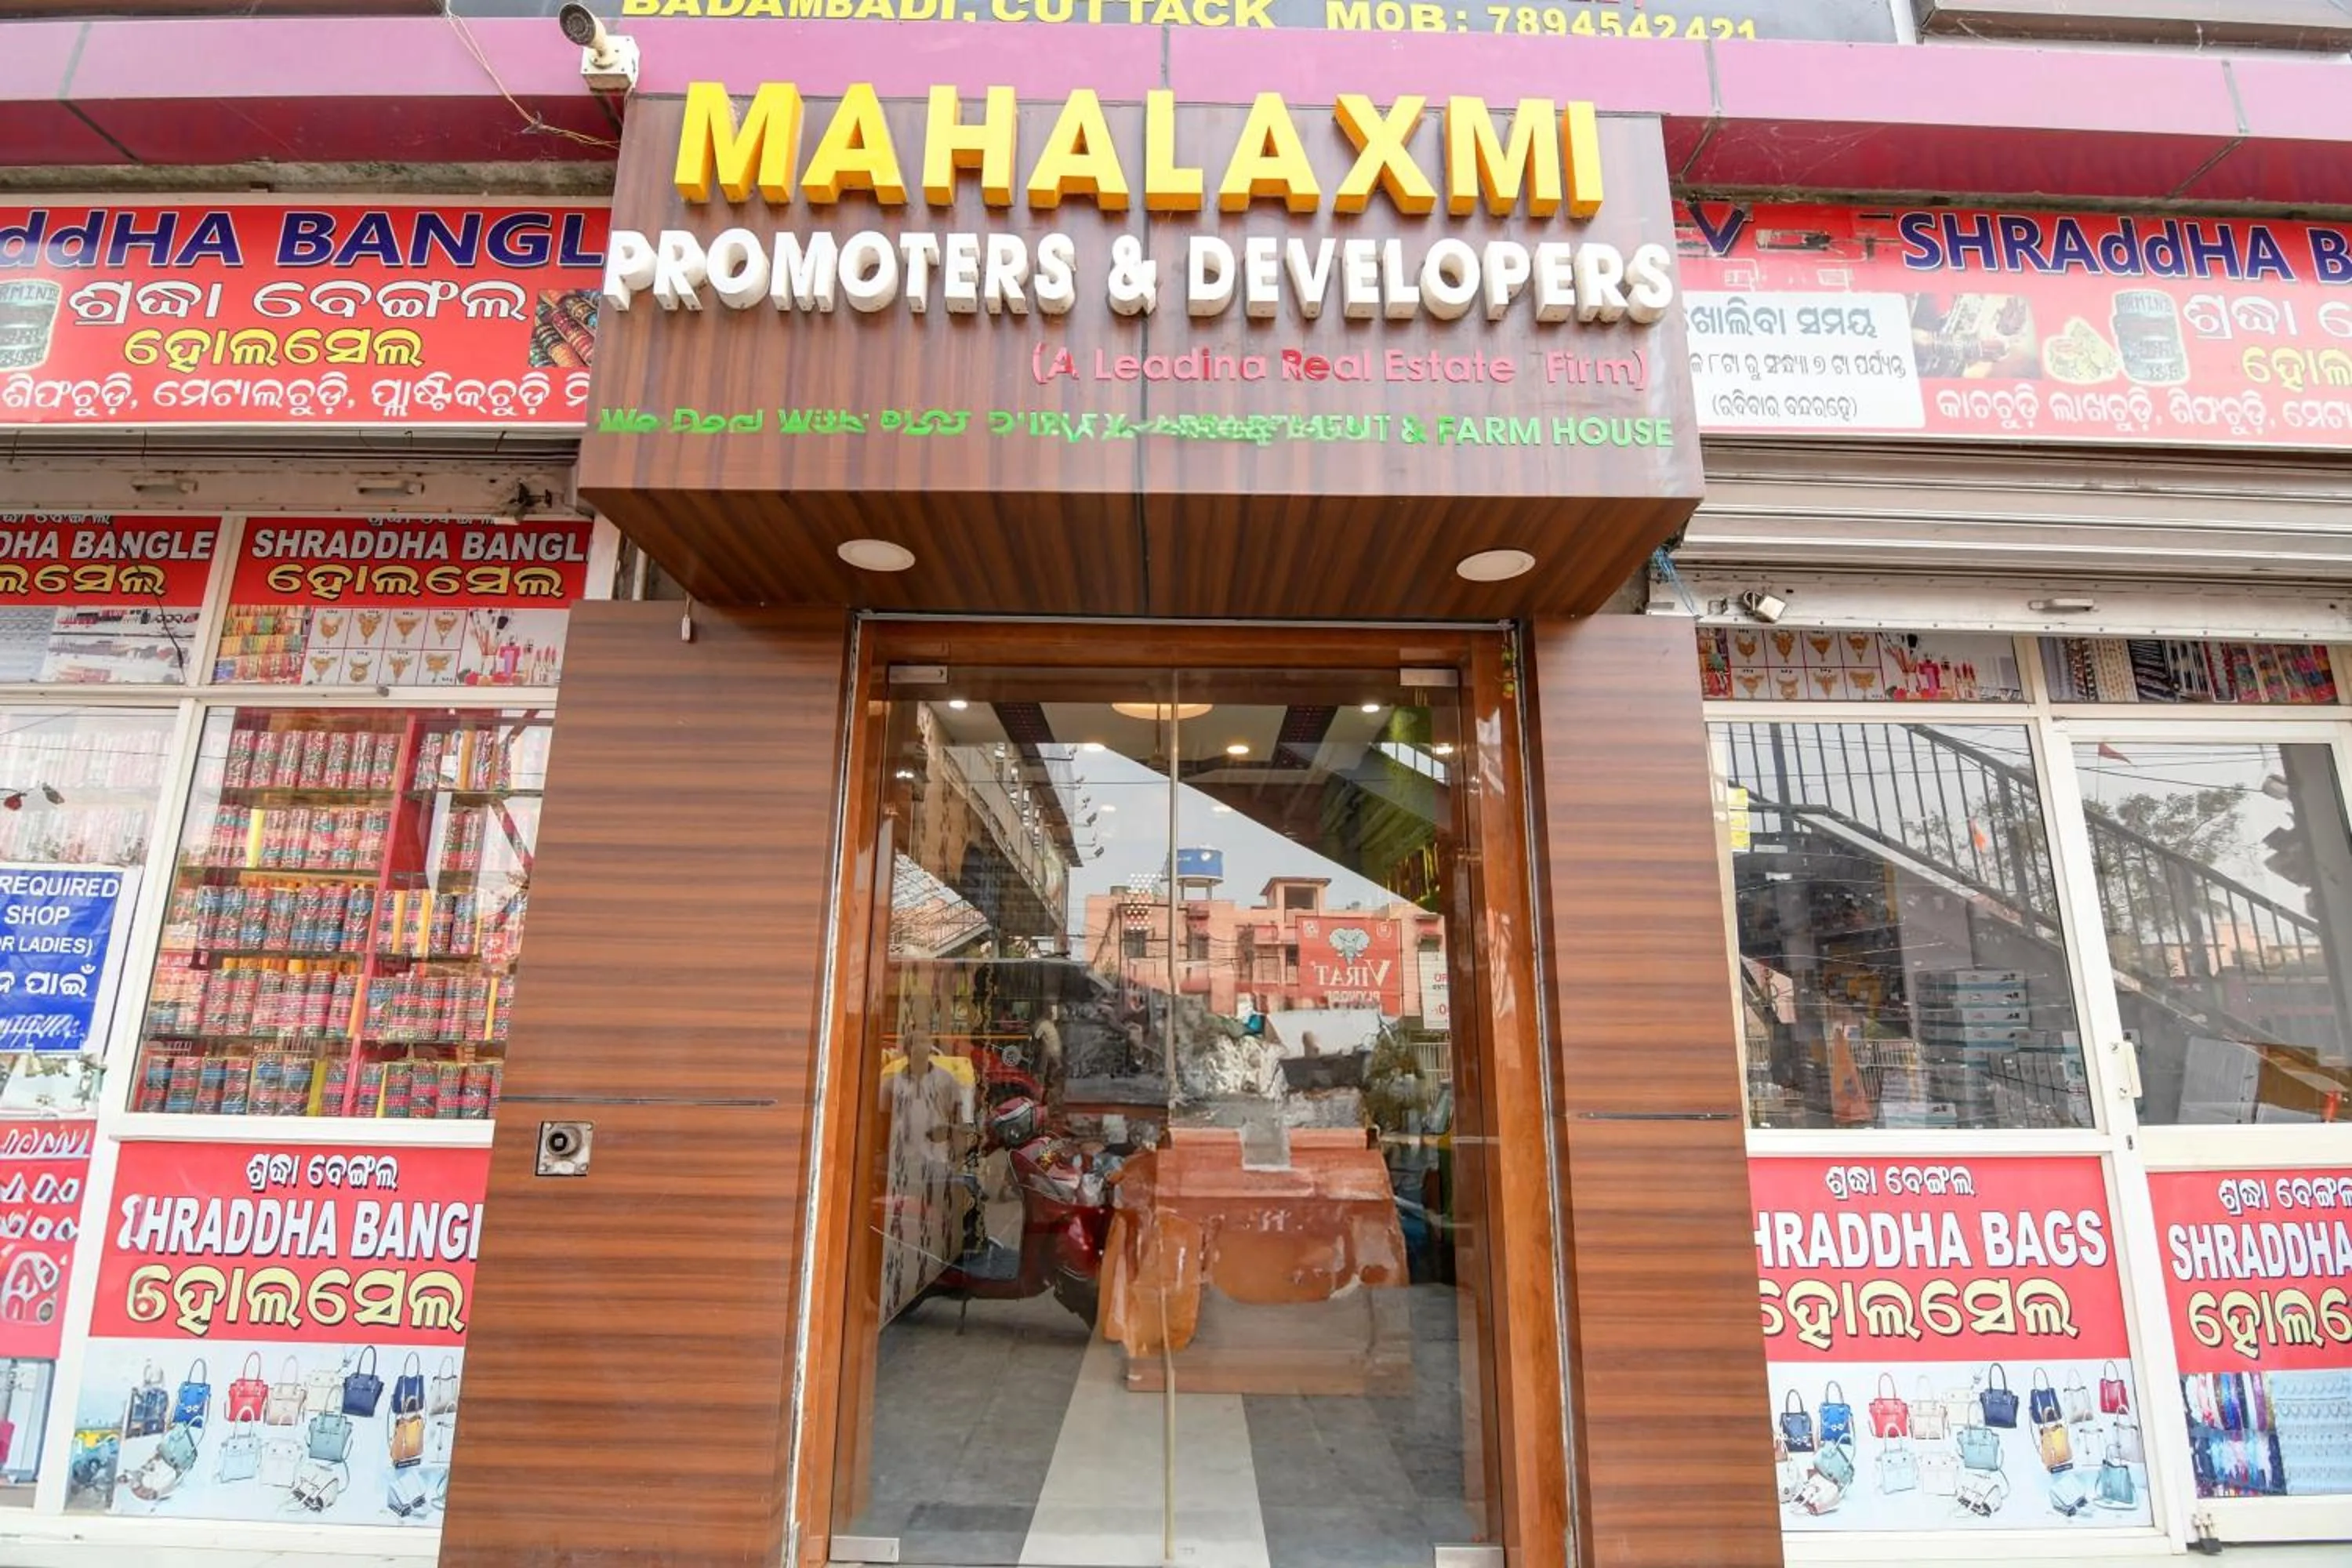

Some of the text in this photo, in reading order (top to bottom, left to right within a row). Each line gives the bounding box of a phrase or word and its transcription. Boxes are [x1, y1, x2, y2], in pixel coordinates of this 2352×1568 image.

[991, 0, 1276, 28] CUTTACK
[1325, 0, 1468, 32] MOB:
[1487, 7, 1756, 40] 7894542421
[673, 82, 1604, 220] MAHALAXMI
[275, 211, 605, 268] BANGL
[1898, 212, 2297, 282] SHRAddHA
[602, 227, 1675, 325] PROMOTERS & DEVELOPERS
[123, 327, 426, 374] ହୋଲସେଲ
[1281, 347, 1371, 382] Real
[1385, 348, 1516, 383] Estate
[1544, 350, 1649, 391] Firm)
[1438, 416, 1541, 445] FARM
[1552, 416, 1675, 447] HOUSE
[71, 530, 216, 560] BANGLE
[251, 528, 593, 562] SHRADDHA BANGL
[267, 563, 564, 599] ହୋଲସେଲ
[4, 905, 71, 926] SHOP
[18, 937, 93, 957] LADIES)
[1979, 1209, 2108, 1268] BAGS
